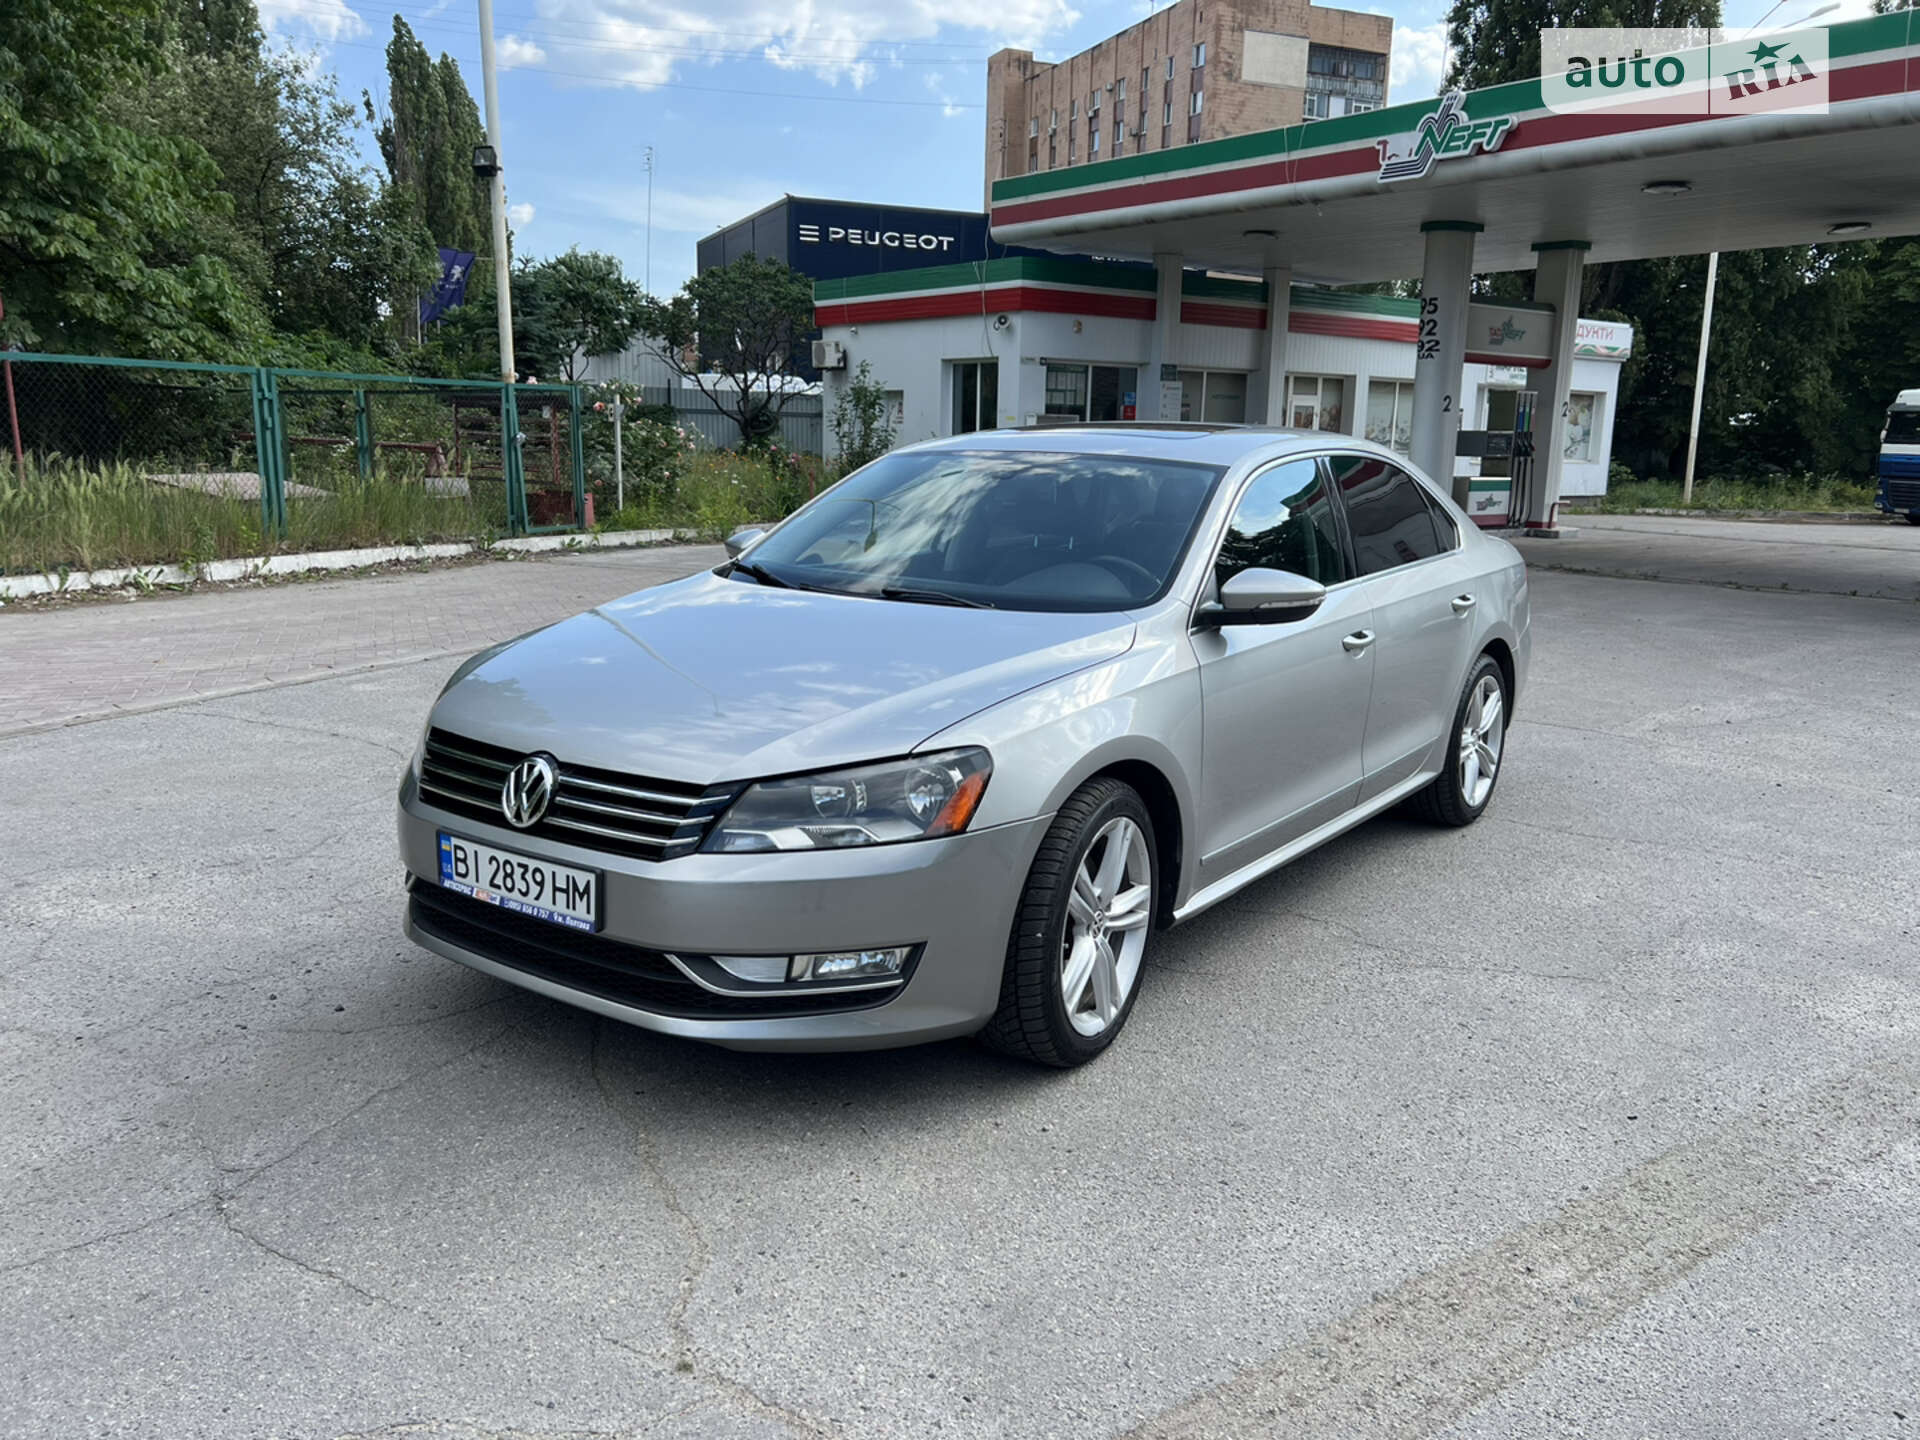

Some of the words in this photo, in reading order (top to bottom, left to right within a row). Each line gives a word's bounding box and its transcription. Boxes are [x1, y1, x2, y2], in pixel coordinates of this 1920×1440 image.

[1414, 118, 1512, 157] NEFT
[828, 227, 955, 251] PEUGEOT
[1442, 395, 1452, 413] 2
[453, 843, 479, 883] BI
[488, 855, 545, 901] 2839
[551, 871, 591, 915] HM
